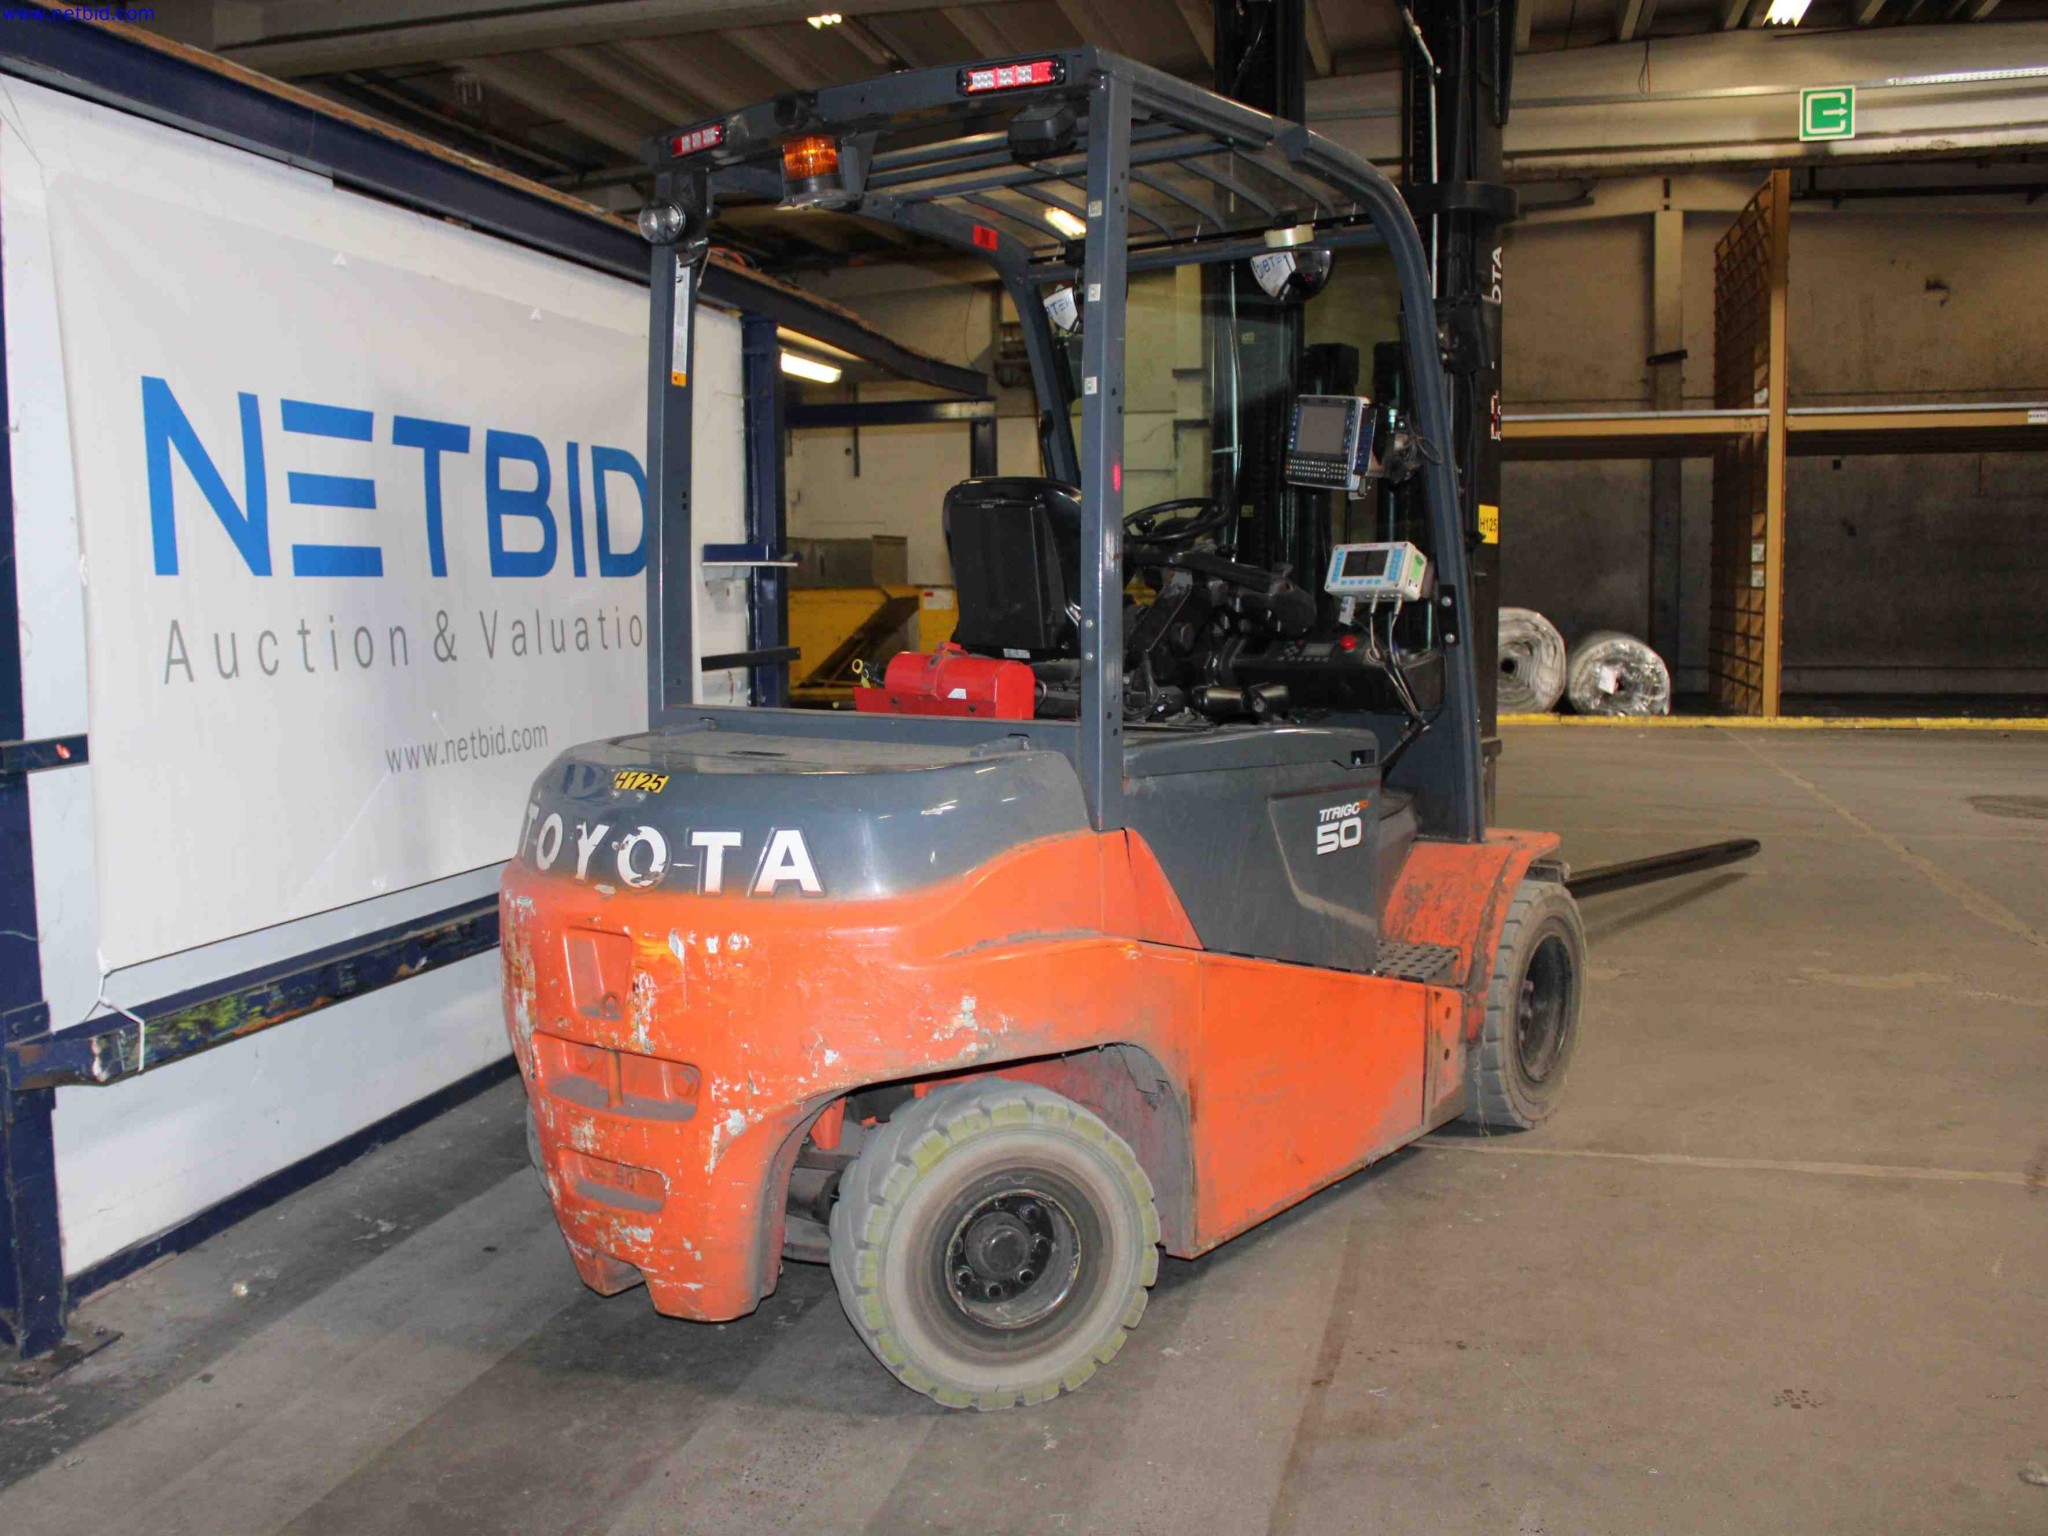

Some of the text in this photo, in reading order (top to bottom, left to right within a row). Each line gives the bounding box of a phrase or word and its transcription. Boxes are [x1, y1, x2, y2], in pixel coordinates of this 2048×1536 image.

[141, 375, 648, 577] NETBID
[1480, 517, 1498, 532] H125
[163, 605, 643, 685] Auction & Valuatio
[385, 723, 548, 774] www.netbid.com
[615, 771, 665, 792] H125
[519, 803, 823, 894] TOYOTA
[1317, 816, 1362, 855] 50
